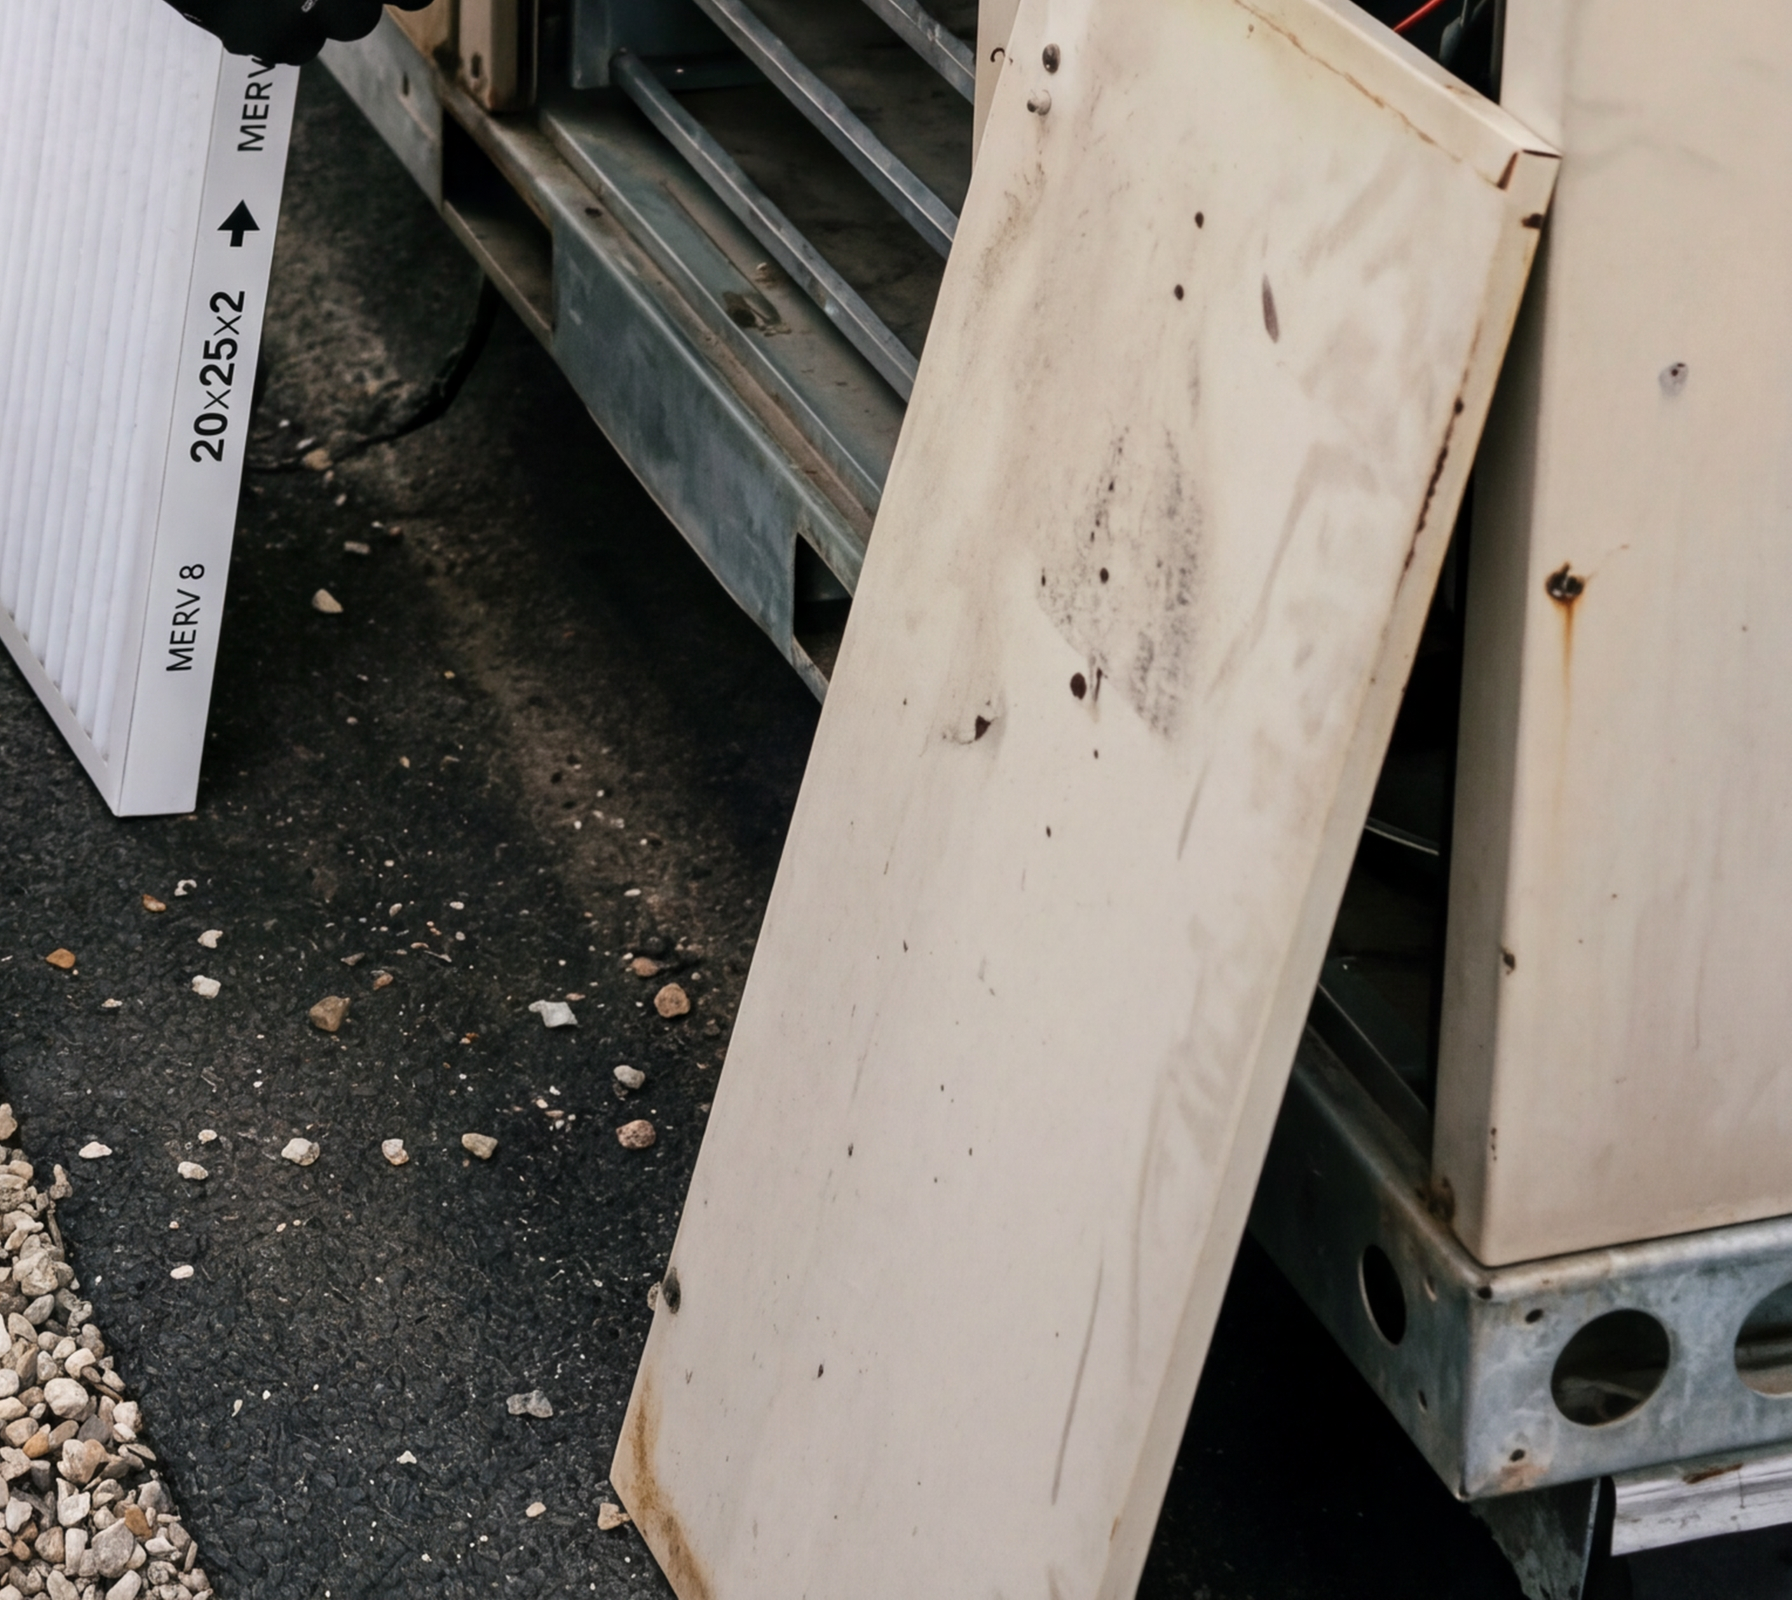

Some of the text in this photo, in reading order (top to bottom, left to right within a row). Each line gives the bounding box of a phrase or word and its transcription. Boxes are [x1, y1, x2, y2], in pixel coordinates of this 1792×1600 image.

[236, 57, 276, 152] MERV
[189, 290, 246, 463] 20x25x2
[165, 563, 206, 672] MERV 8
